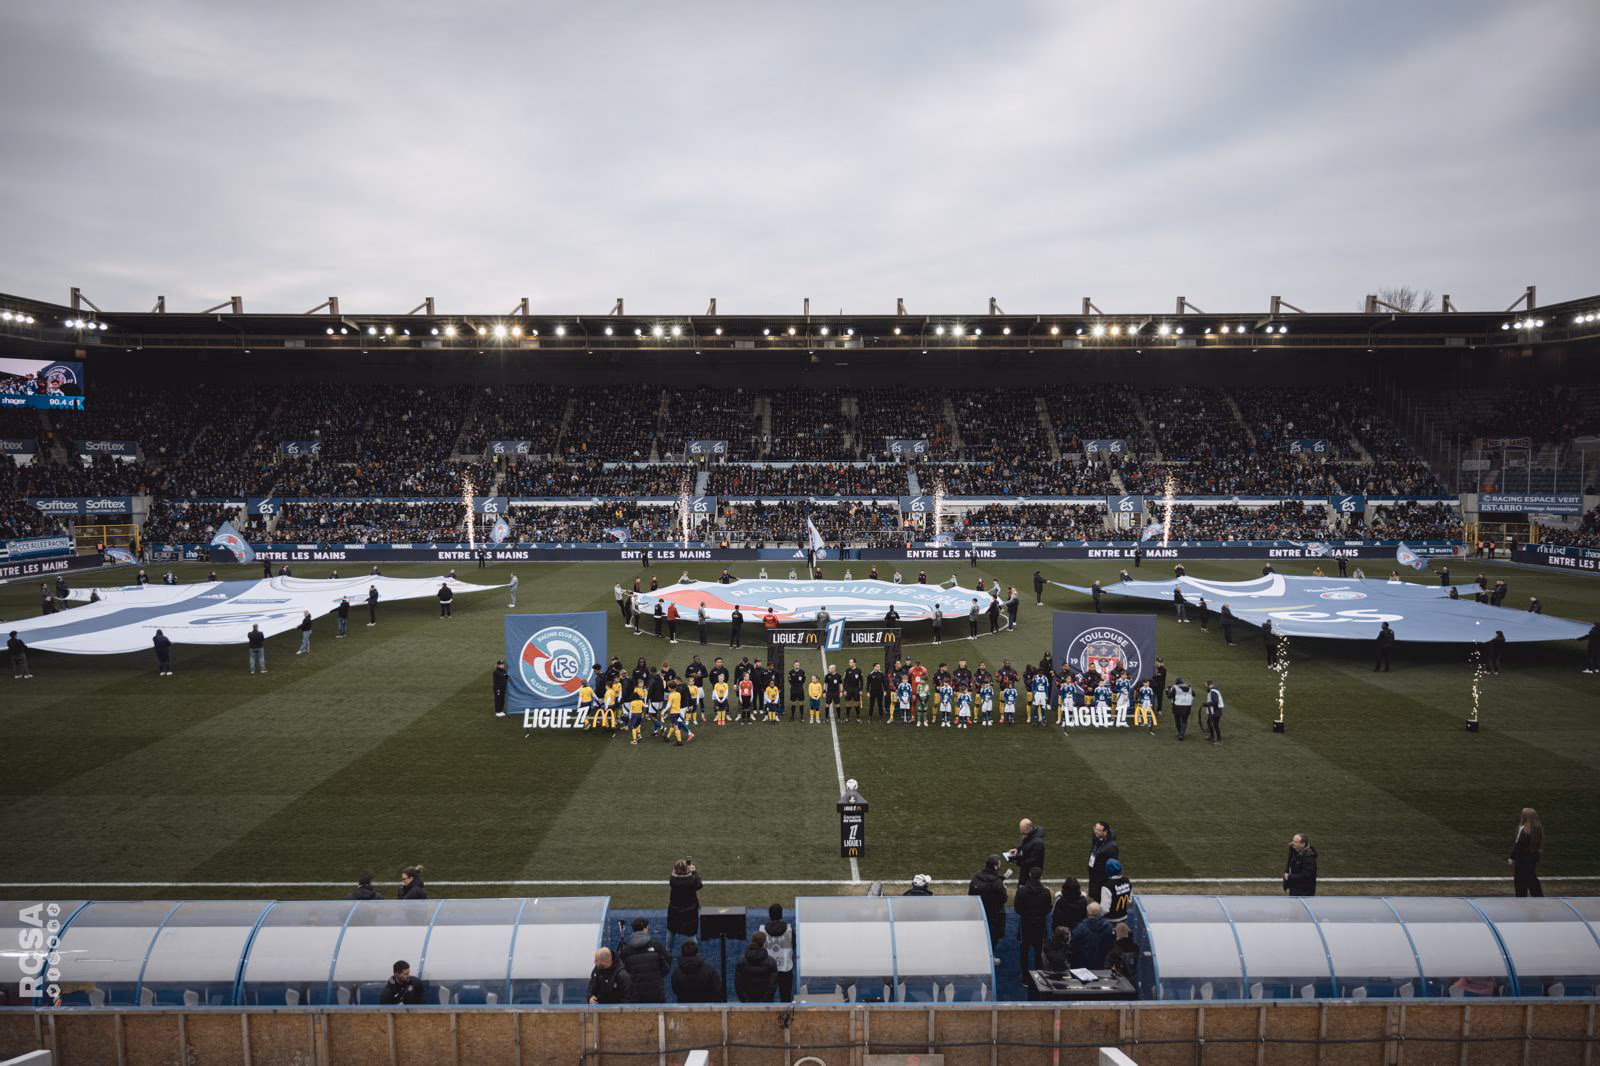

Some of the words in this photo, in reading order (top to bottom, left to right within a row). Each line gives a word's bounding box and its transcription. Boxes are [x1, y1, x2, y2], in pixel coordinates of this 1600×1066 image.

[1481, 504, 1522, 512] EST-ARRO
[48, 539, 69, 548] RACING
[255, 552, 288, 560] ENTRE
[292, 552, 310, 560] LES
[314, 551, 346, 560] MAINS
[438, 551, 471, 559] ENTRE
[475, 551, 493, 559] LS
[496, 551, 529, 559] MAINS
[657, 550, 675, 559] LES
[679, 550, 712, 559] MAINS
[906, 550, 938, 558] ENTRE
[943, 550, 961, 558] LES
[1088, 549, 1120, 557] ENTRE
[1124, 549, 1143, 557] LE
[1146, 549, 1178, 557] MAINS
[1269, 549, 1301, 557] ENTRE
[24, 564, 39, 573] LES
[42, 560, 69, 572] MAINS
[1548, 556, 1576, 567] ENTRE
[1579, 559, 1595, 569] LES
[730, 586, 816, 598] RACING
[823, 586, 883, 595] CLUB
[772, 633, 796, 644] LIGUE
[851, 633, 875, 643] LIGUE
[1079, 631, 1129, 648] TOULOUSE
[1128, 660, 1139, 668] 37
[523, 708, 573, 728] LIGUE
[1064, 706, 1112, 727] LIGUE
[843, 839, 858, 847] LIGUE
